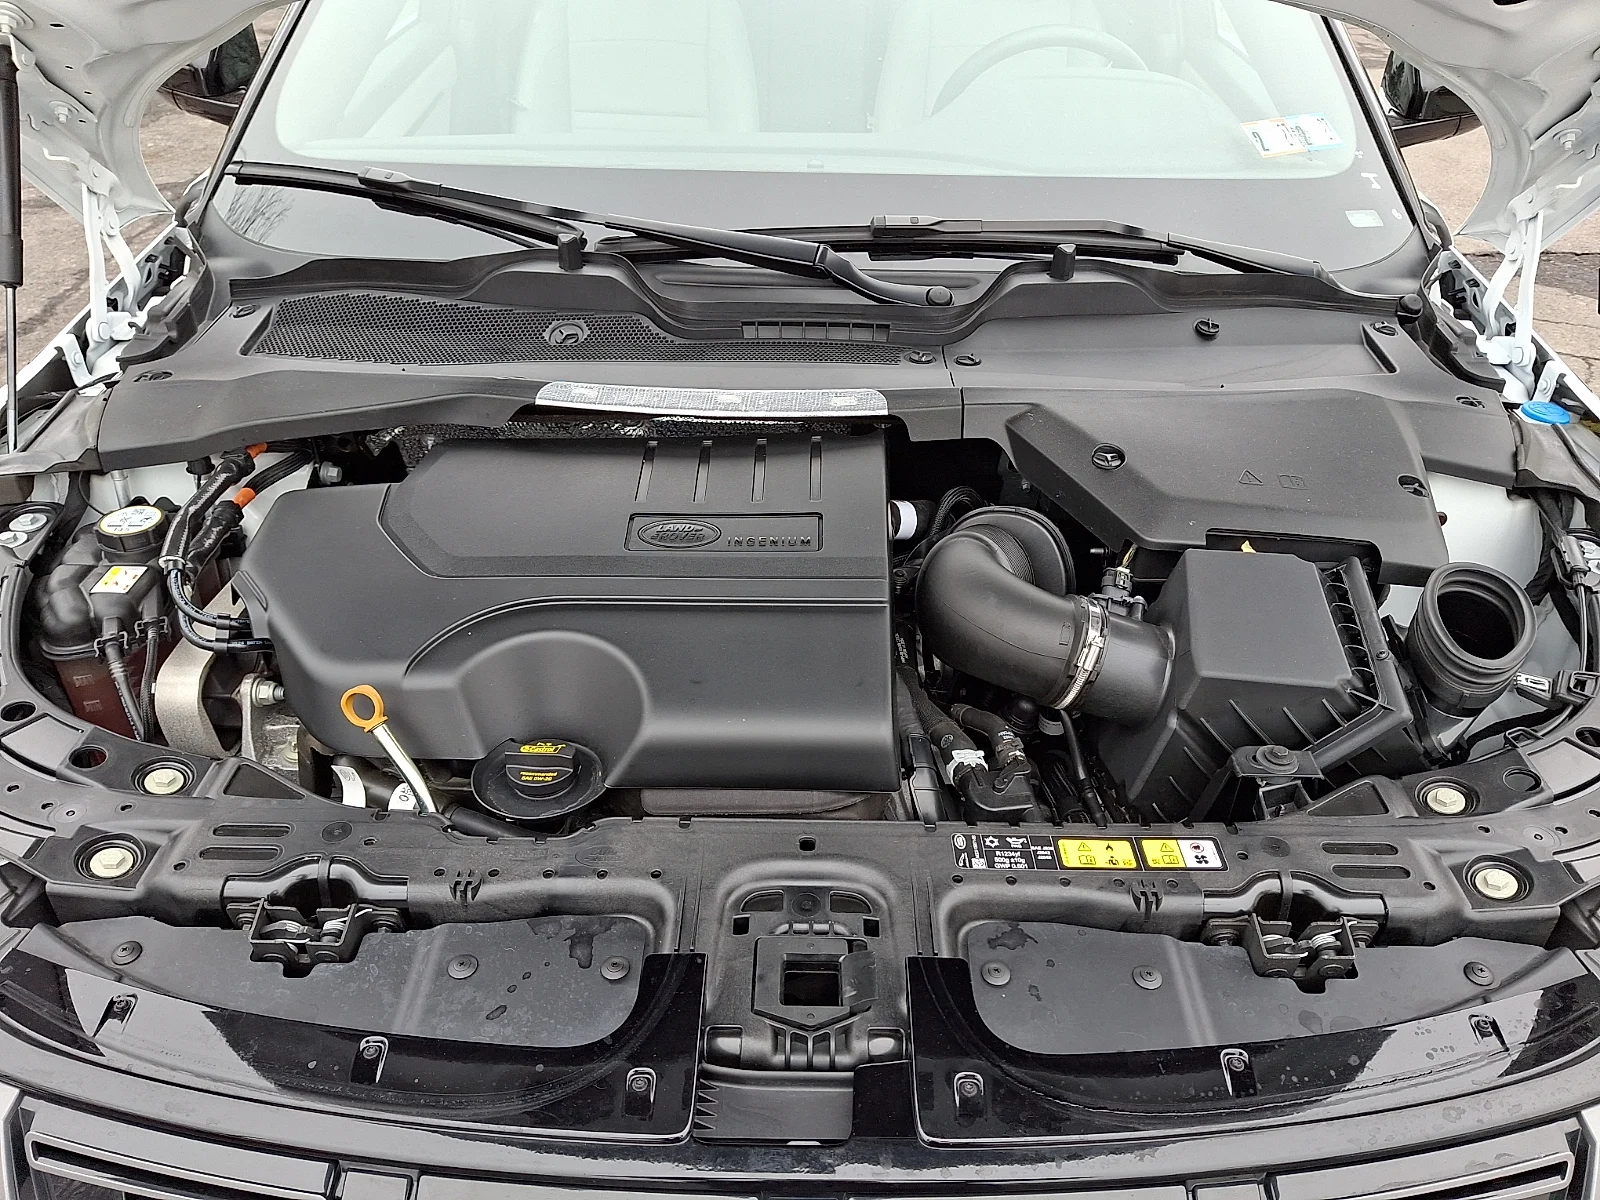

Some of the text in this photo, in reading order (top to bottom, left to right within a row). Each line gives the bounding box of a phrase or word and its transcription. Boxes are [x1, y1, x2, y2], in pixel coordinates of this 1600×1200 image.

[656, 524, 693, 533] LAND
[657, 532, 706, 542] ROVER
[727, 536, 812, 547] INGENIUM
